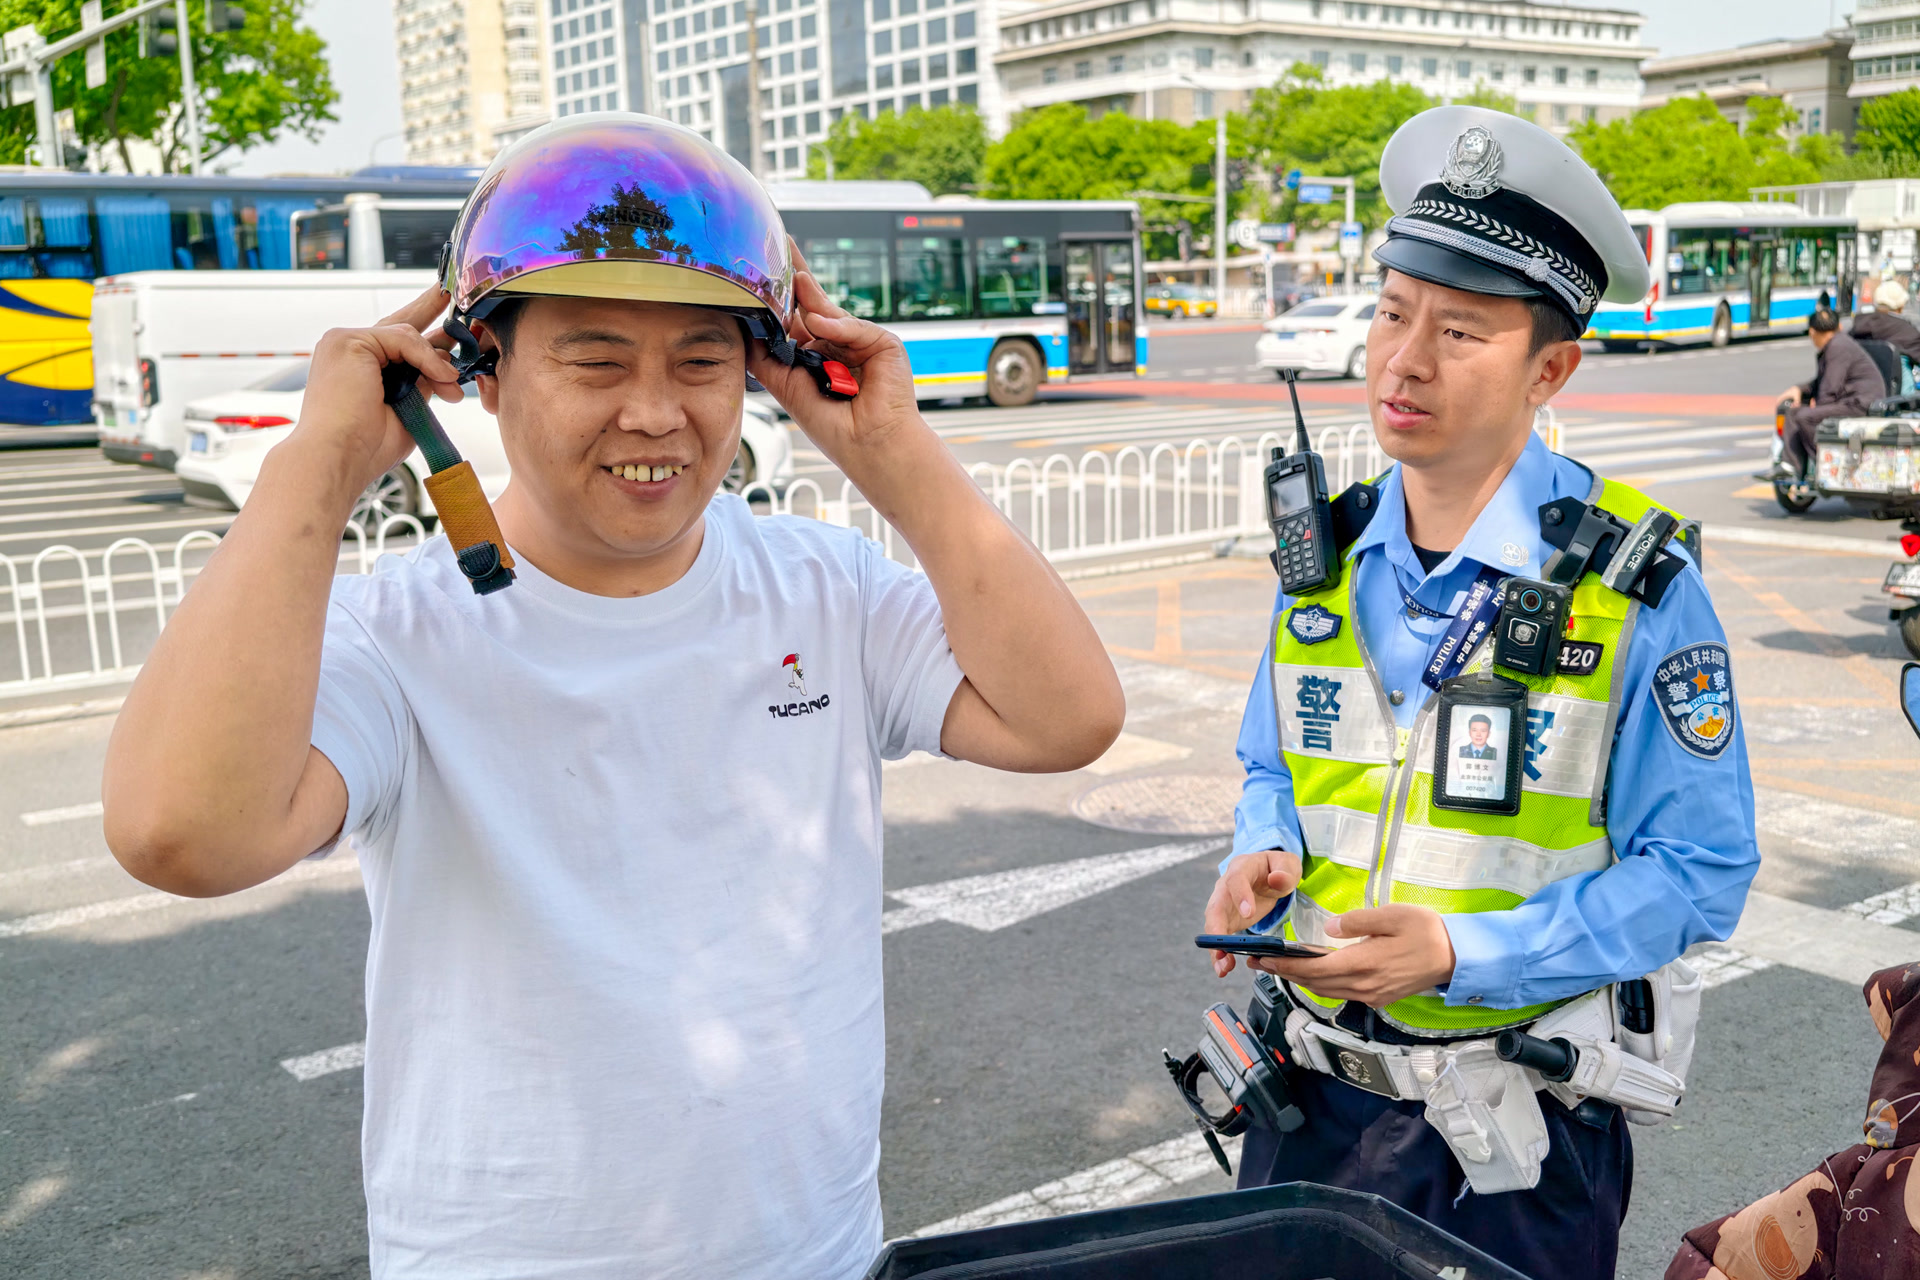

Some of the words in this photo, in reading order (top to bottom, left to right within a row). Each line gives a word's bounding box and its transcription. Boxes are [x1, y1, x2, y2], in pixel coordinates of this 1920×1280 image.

[1627, 533, 1656, 570] POLICE
[1428, 635, 1458, 675] POLICE
[1455, 620, 1486, 665] 中国警察
[1560, 646, 1595, 668] 420
[1656, 648, 1726, 684] 中华人民共和国
[768, 693, 831, 719] TUCANO
[1689, 694, 1720, 711] POLICE
